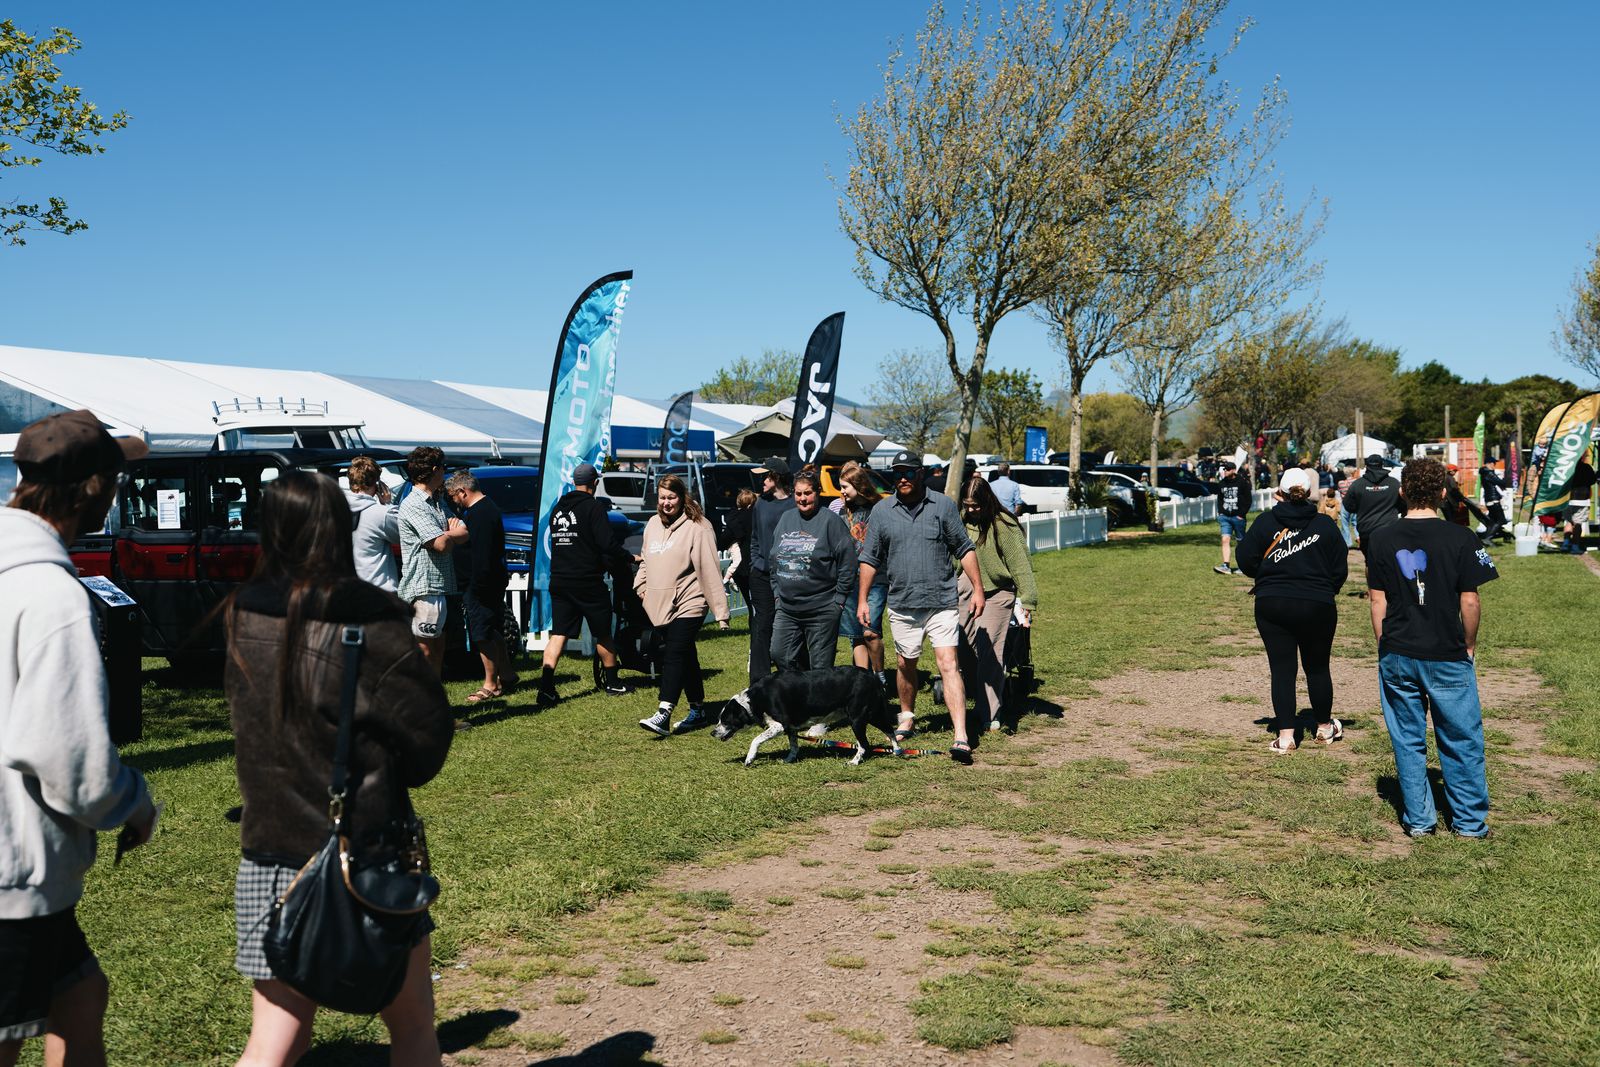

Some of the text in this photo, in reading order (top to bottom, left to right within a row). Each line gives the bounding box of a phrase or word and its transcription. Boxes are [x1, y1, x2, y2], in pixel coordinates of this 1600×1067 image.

[798, 362, 831, 463] JAC
[802, 543, 816, 552] 88
[1267, 533, 1320, 563] Balance
